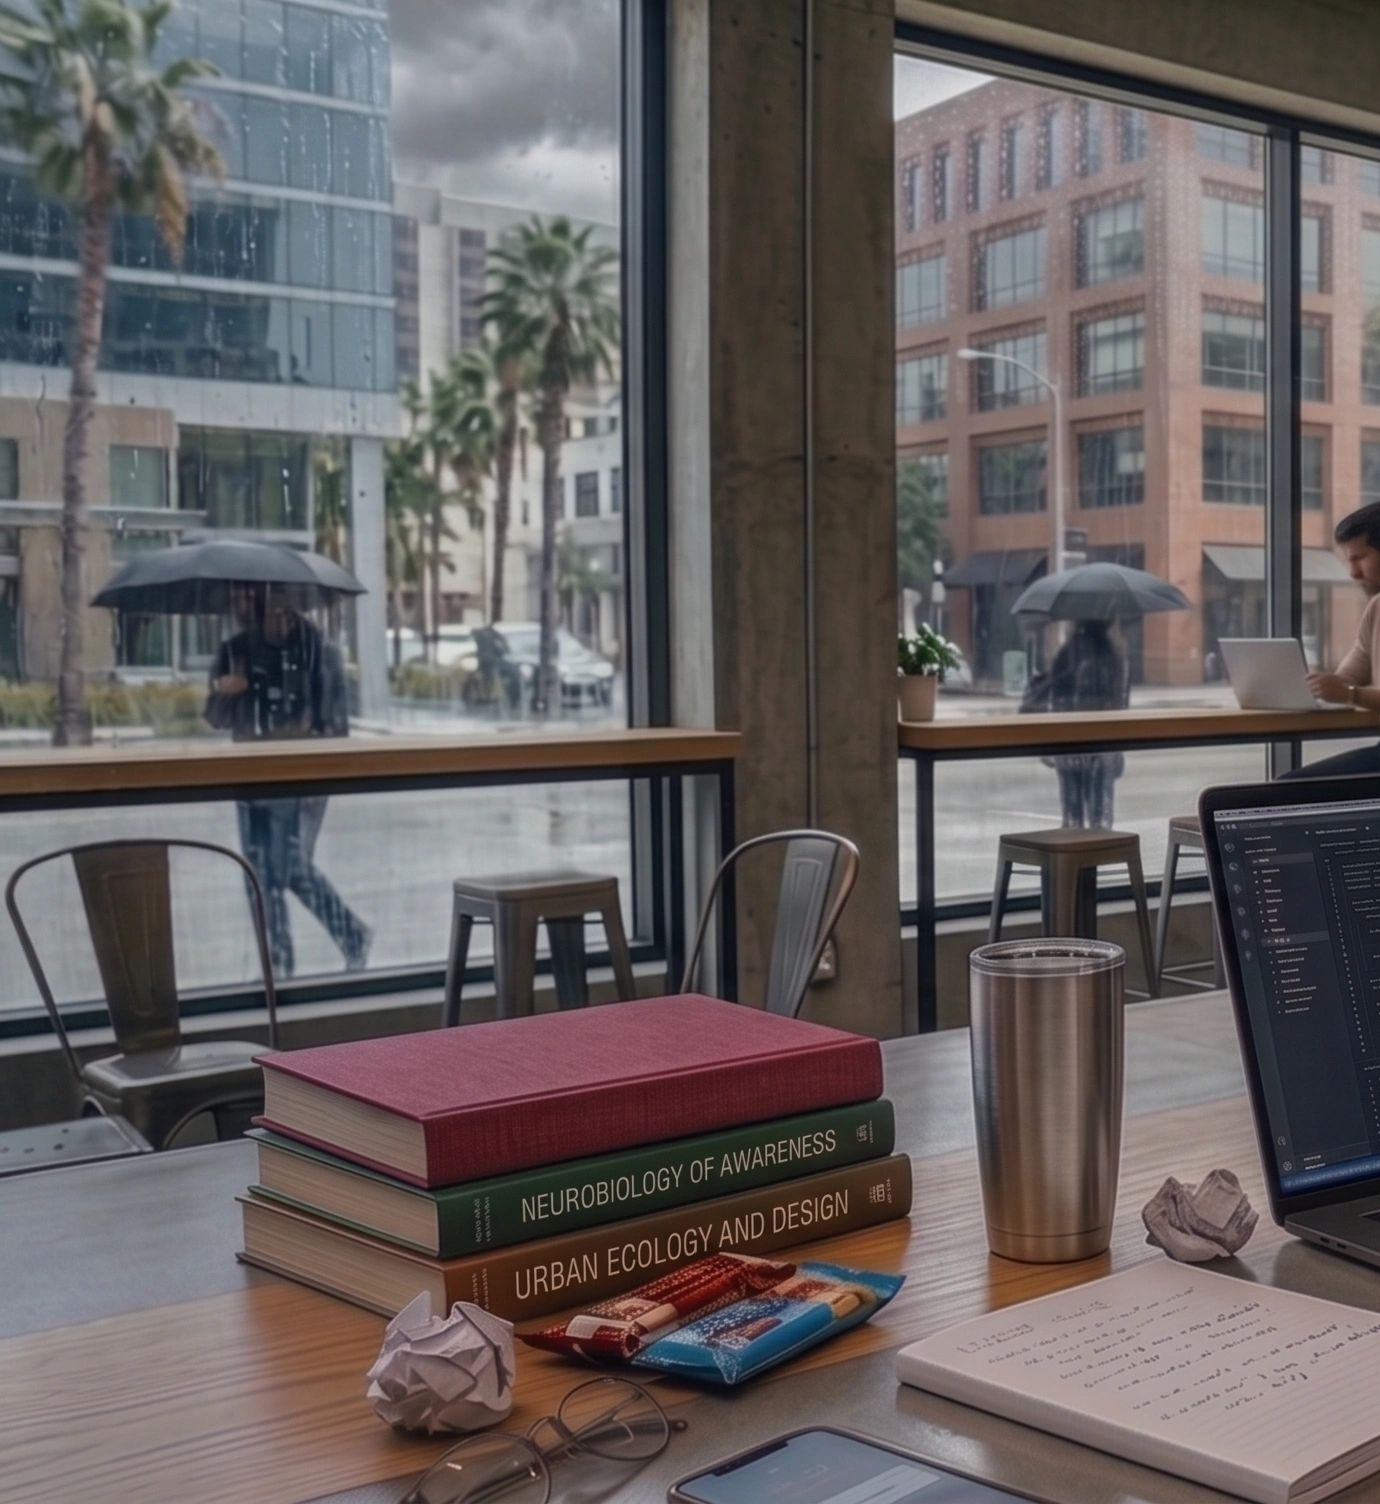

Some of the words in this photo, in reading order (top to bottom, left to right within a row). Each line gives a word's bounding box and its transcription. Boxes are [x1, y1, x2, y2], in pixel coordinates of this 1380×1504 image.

[521, 1164, 683, 1223] NEUROBIOLOGY
[690, 1156, 715, 1183] OF
[720, 1129, 837, 1178] AWARENESS
[514, 1252, 598, 1300] URBAN
[607, 1223, 713, 1276] ECOLOGY
[718, 1212, 765, 1248] AND
[773, 1190, 850, 1234] DESIGN
